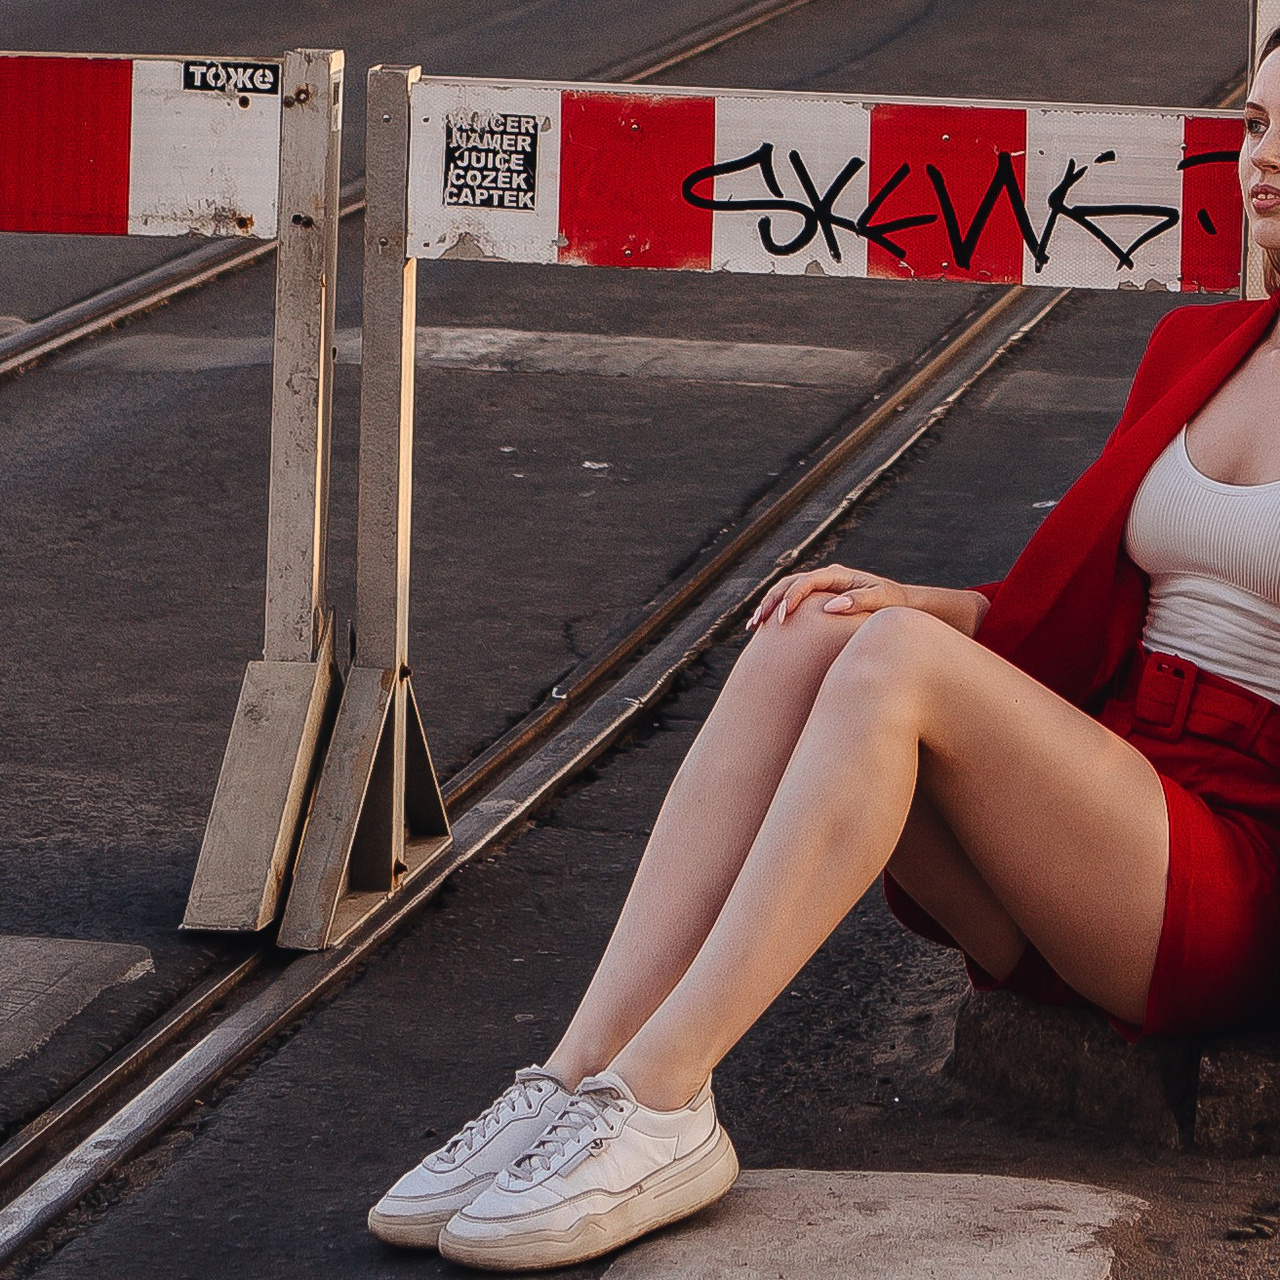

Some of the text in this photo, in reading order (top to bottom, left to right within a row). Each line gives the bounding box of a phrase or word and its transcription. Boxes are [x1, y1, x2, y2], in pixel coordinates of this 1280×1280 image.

[456, 150, 525, 171] JUICE
[451, 169, 528, 189] COZEK
[444, 187, 535, 208] CAPTEK
